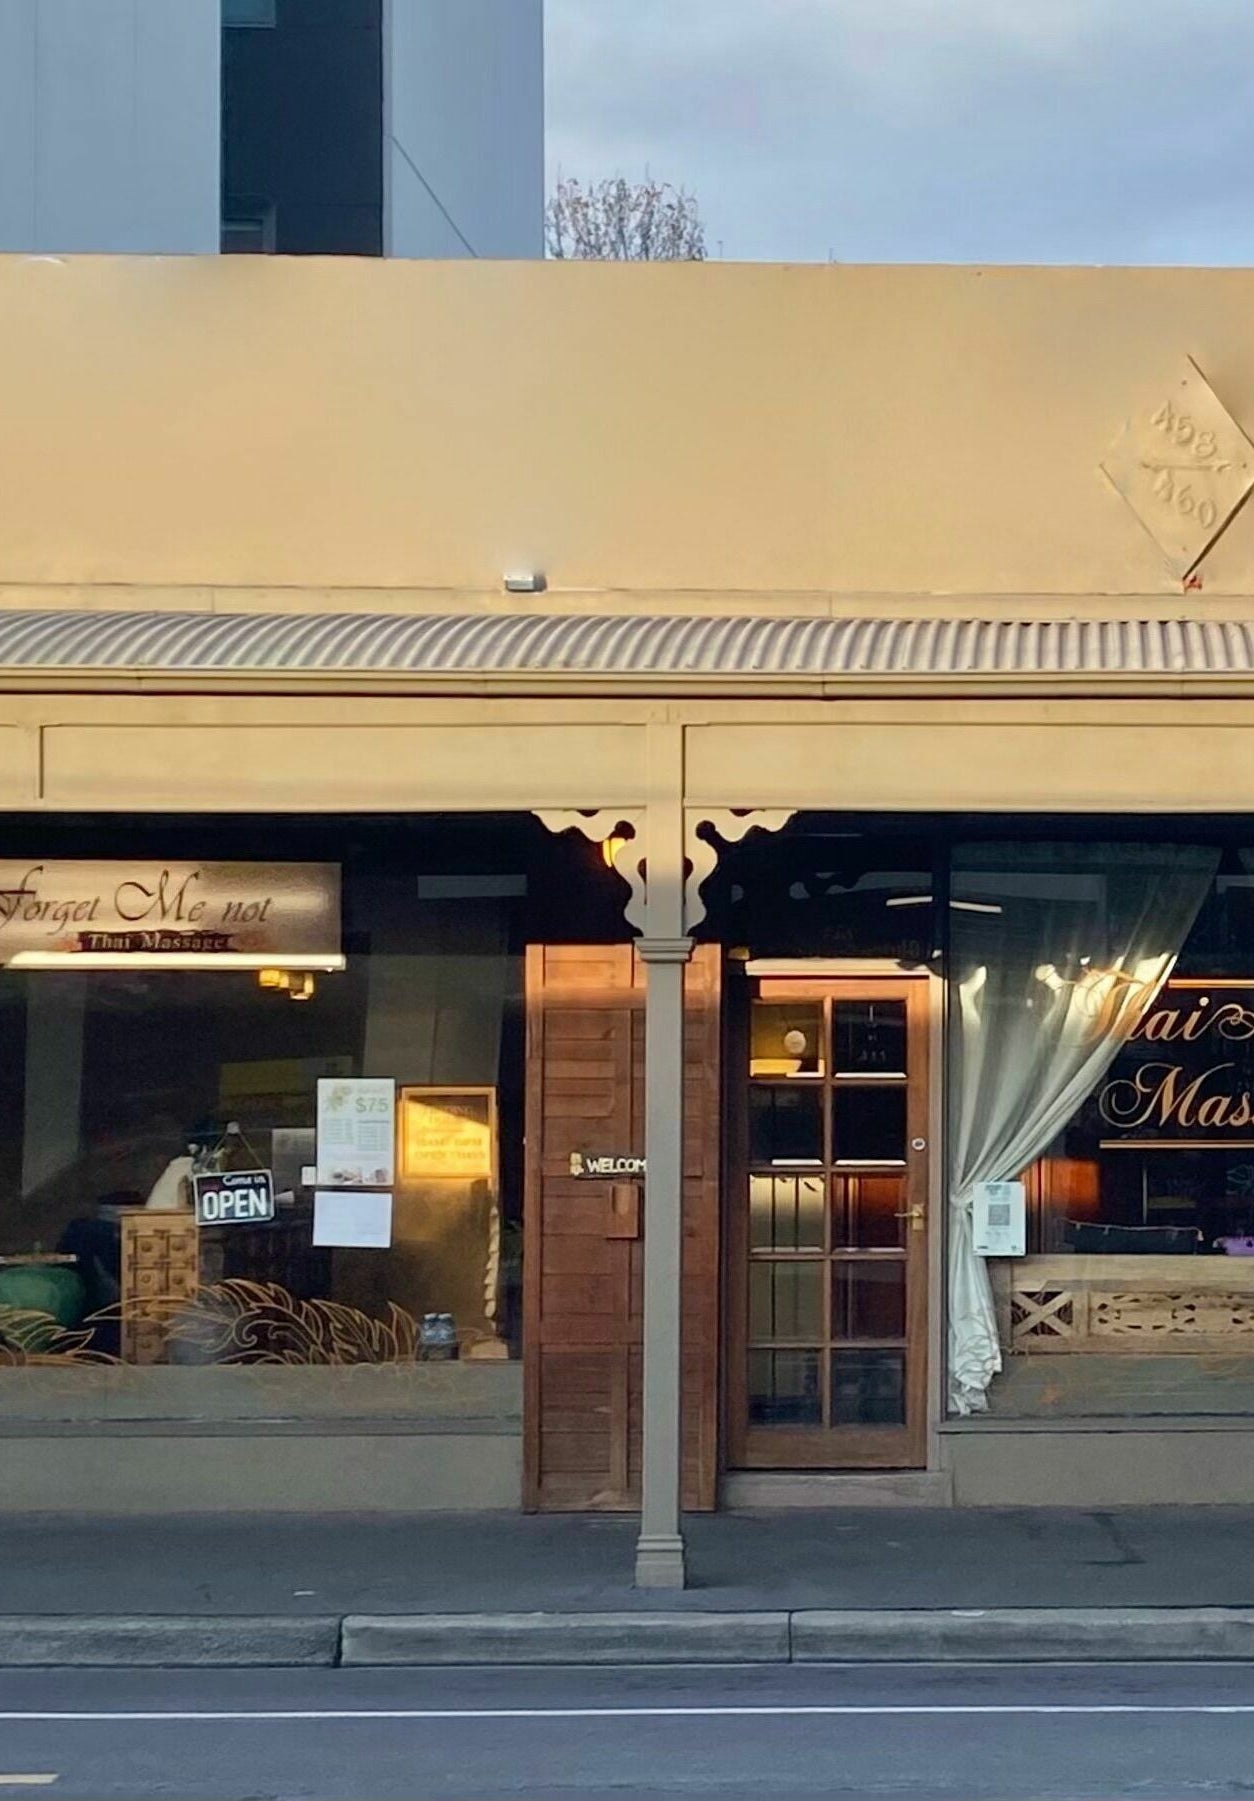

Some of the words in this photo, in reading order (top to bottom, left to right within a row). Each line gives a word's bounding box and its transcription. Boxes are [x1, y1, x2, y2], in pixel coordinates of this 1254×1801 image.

[1152, 401, 1219, 459] 458
[113, 869, 203, 922] Me
[221, 898, 272, 922] not
[88, 934, 131, 950] Thai
[139, 932, 225, 951] Massage
[355, 1097, 390, 1113] $75
[586, 1157, 647, 1173] WELCOM
[202, 1187, 267, 1220] OPEN
